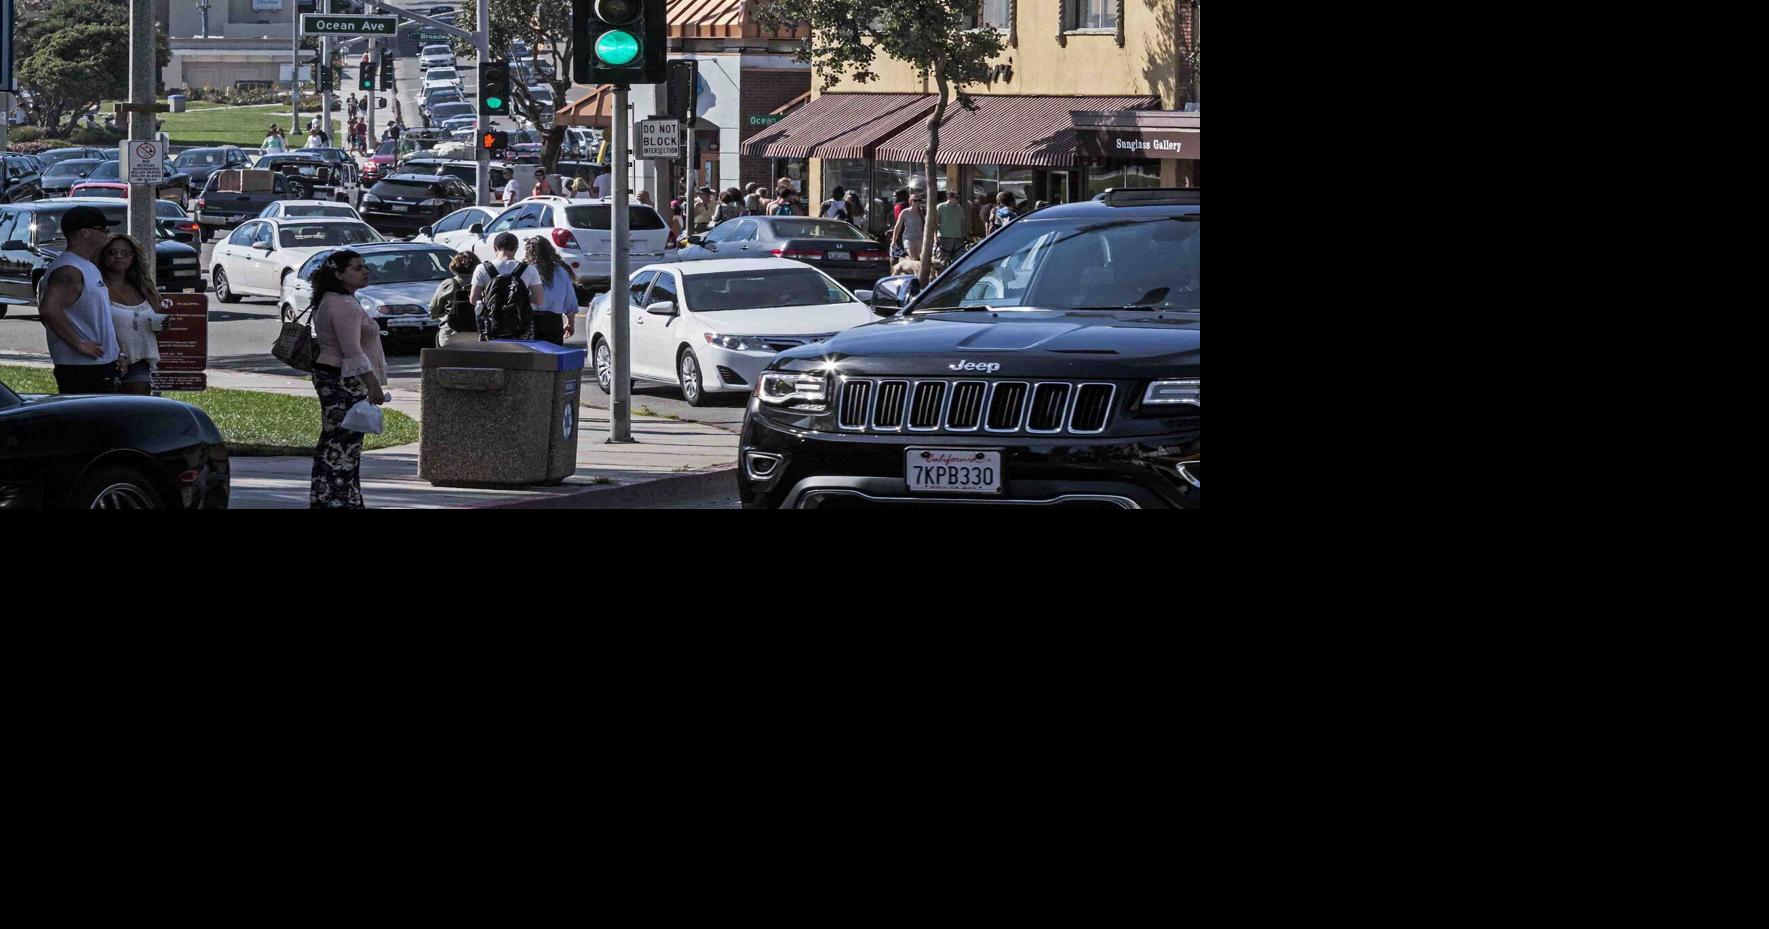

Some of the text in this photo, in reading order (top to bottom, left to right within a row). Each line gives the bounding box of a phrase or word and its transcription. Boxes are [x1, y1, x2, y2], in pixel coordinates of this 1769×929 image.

[316, 20, 385, 31] Ocean Ave
[750, 116, 777, 125] Ocean
[643, 124, 677, 134] DO NOT
[643, 136, 677, 146] BLOCK
[1116, 138, 1182, 152] Sunglass Gallery
[949, 359, 1000, 374] Jeep
[926, 453, 977, 465] California
[913, 465, 994, 486] 7KPB330
